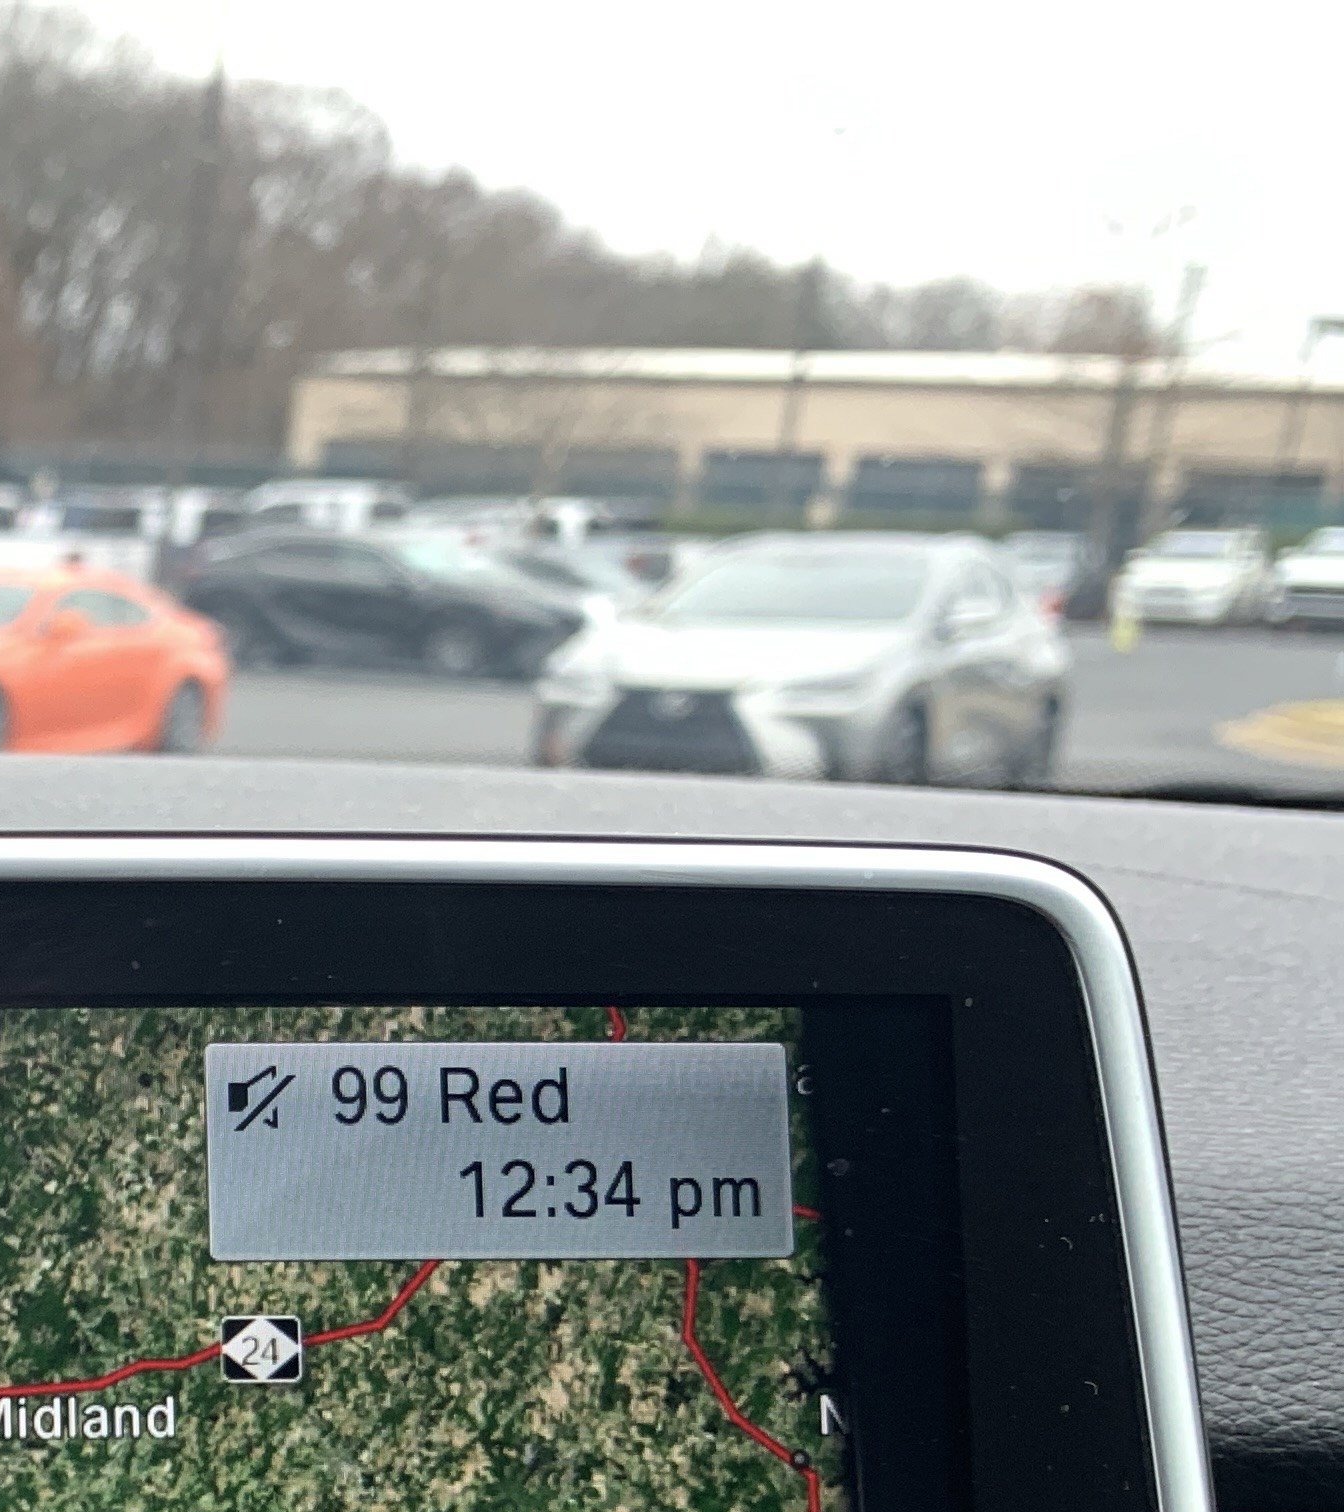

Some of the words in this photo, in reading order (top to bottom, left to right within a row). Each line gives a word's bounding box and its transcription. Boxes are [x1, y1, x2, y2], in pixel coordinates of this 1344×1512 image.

[330, 1066, 408, 1126] 99
[439, 1067, 570, 1125] Red
[459, 1160, 641, 1218] 12:34
[669, 1175, 762, 1229] pm
[241, 1336, 281, 1365] 24
